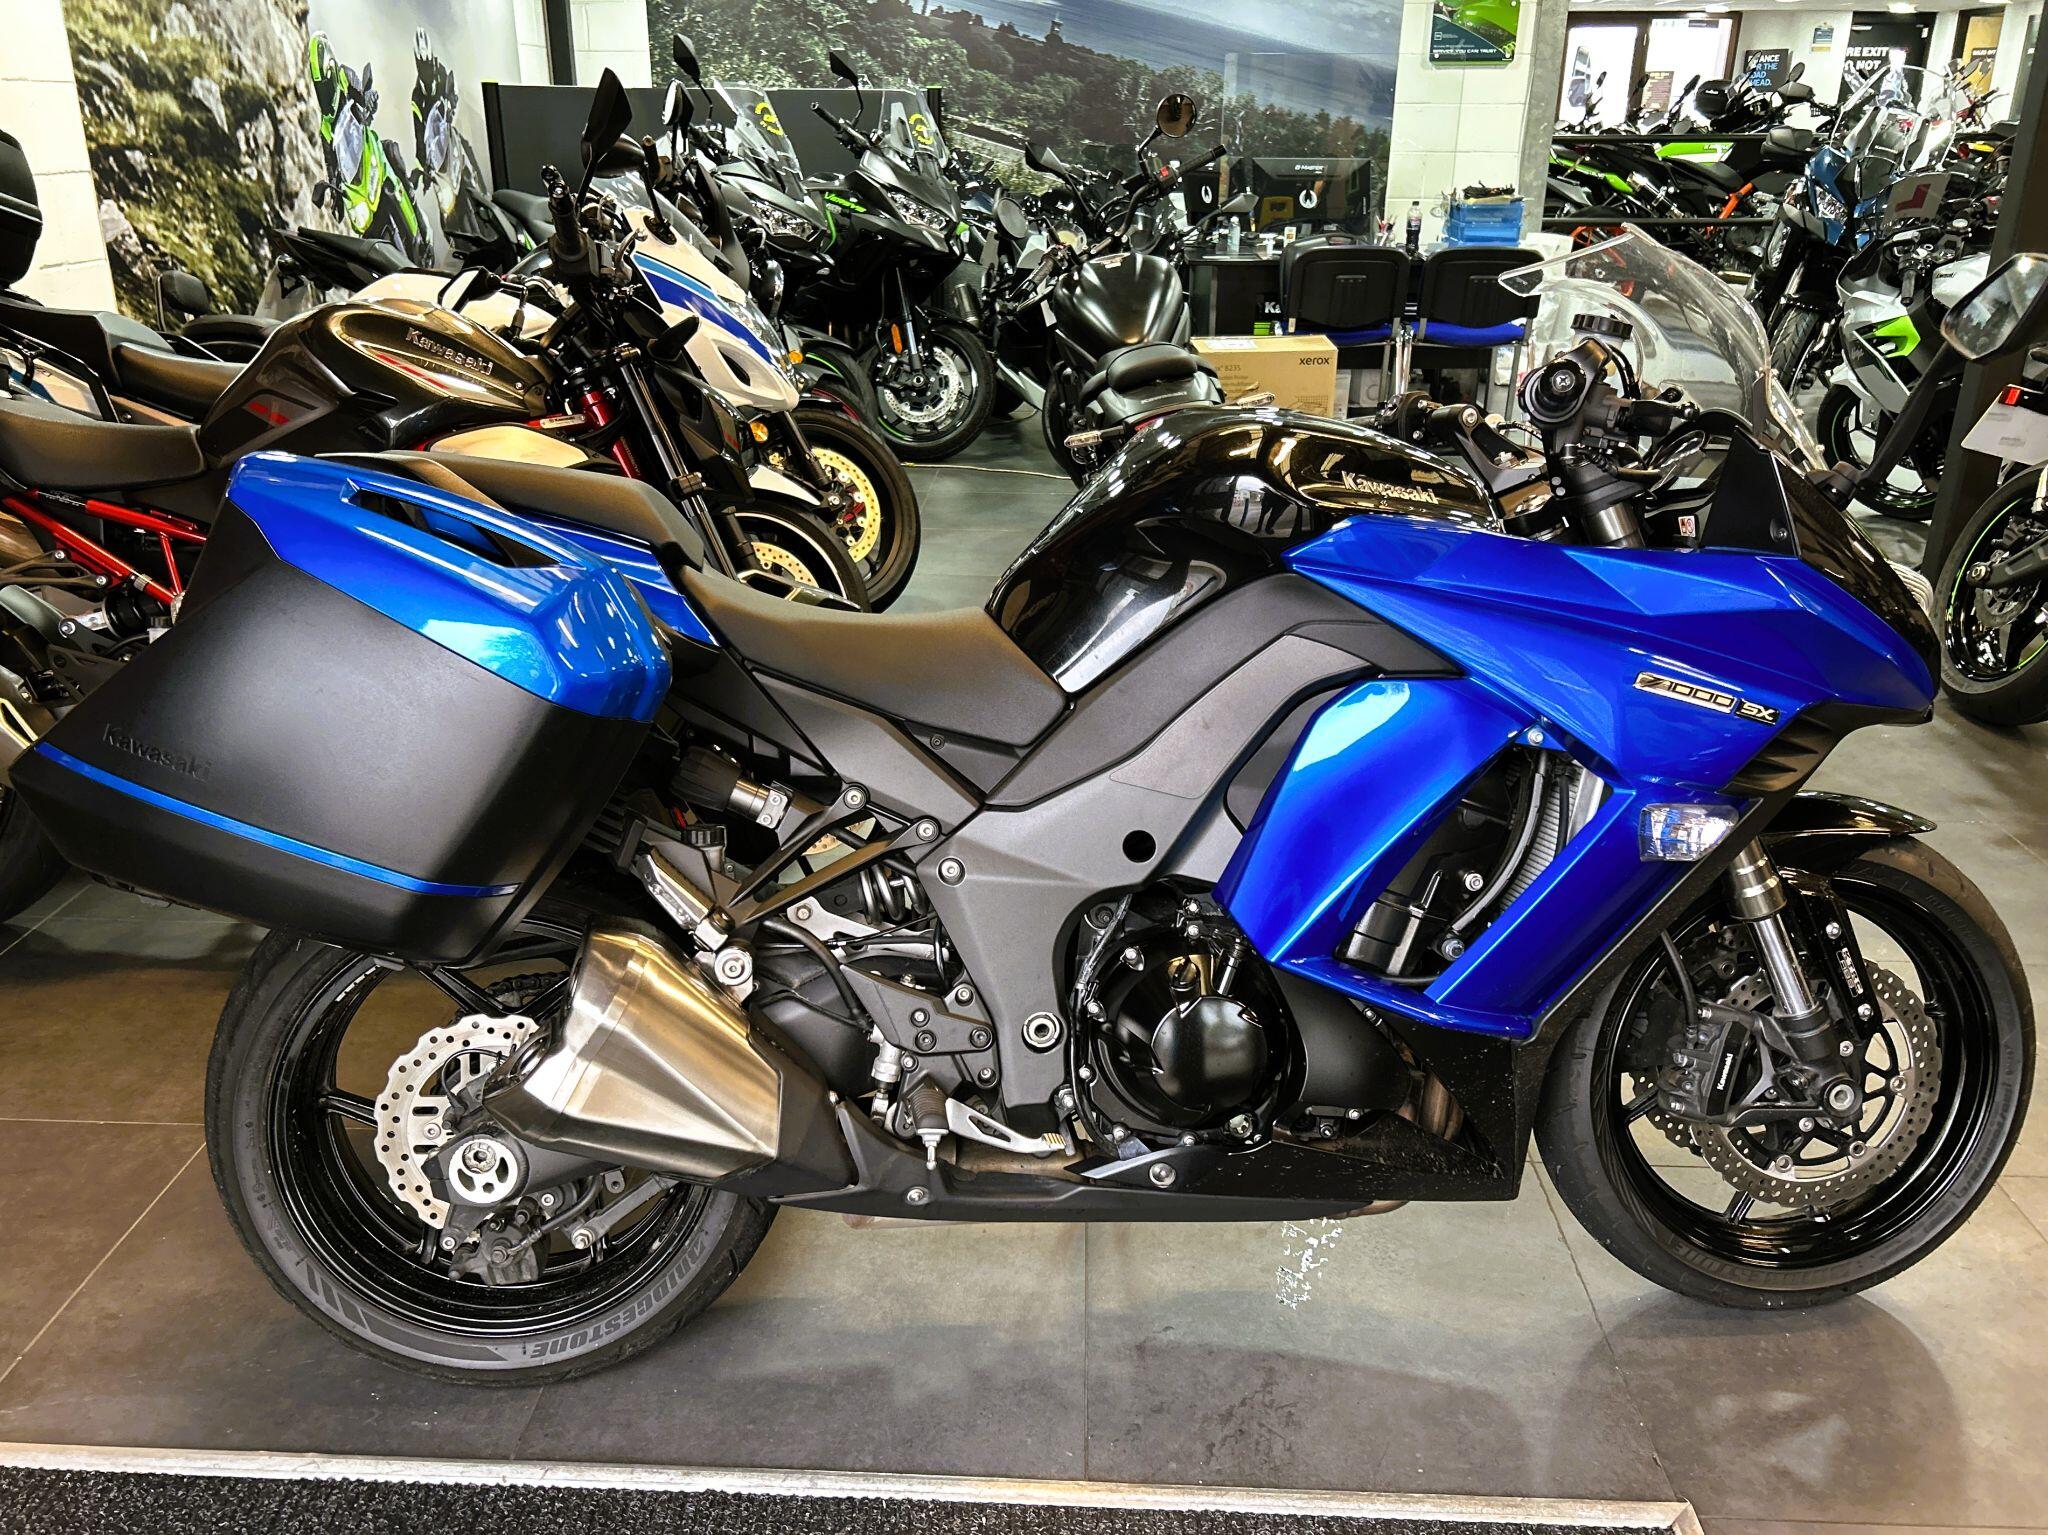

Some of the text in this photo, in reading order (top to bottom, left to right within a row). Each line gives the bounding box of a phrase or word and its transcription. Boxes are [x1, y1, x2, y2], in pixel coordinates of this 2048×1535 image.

[1846, 46, 1889, 57] RE EXIT
[1855, 60, 1882, 71] NOT
[1264, 301, 1282, 314] Ka
[405, 327, 494, 376] Kawasaki
[1298, 355, 1331, 367] xerox
[1341, 470, 1439, 505] Kawasaki
[1740, 700, 1775, 721] SX
[102, 723, 213, 784] Kawasaki
[1716, 1053, 1734, 1091] Kawasaki
[530, 1240, 708, 1359] BRIDGESTONE
